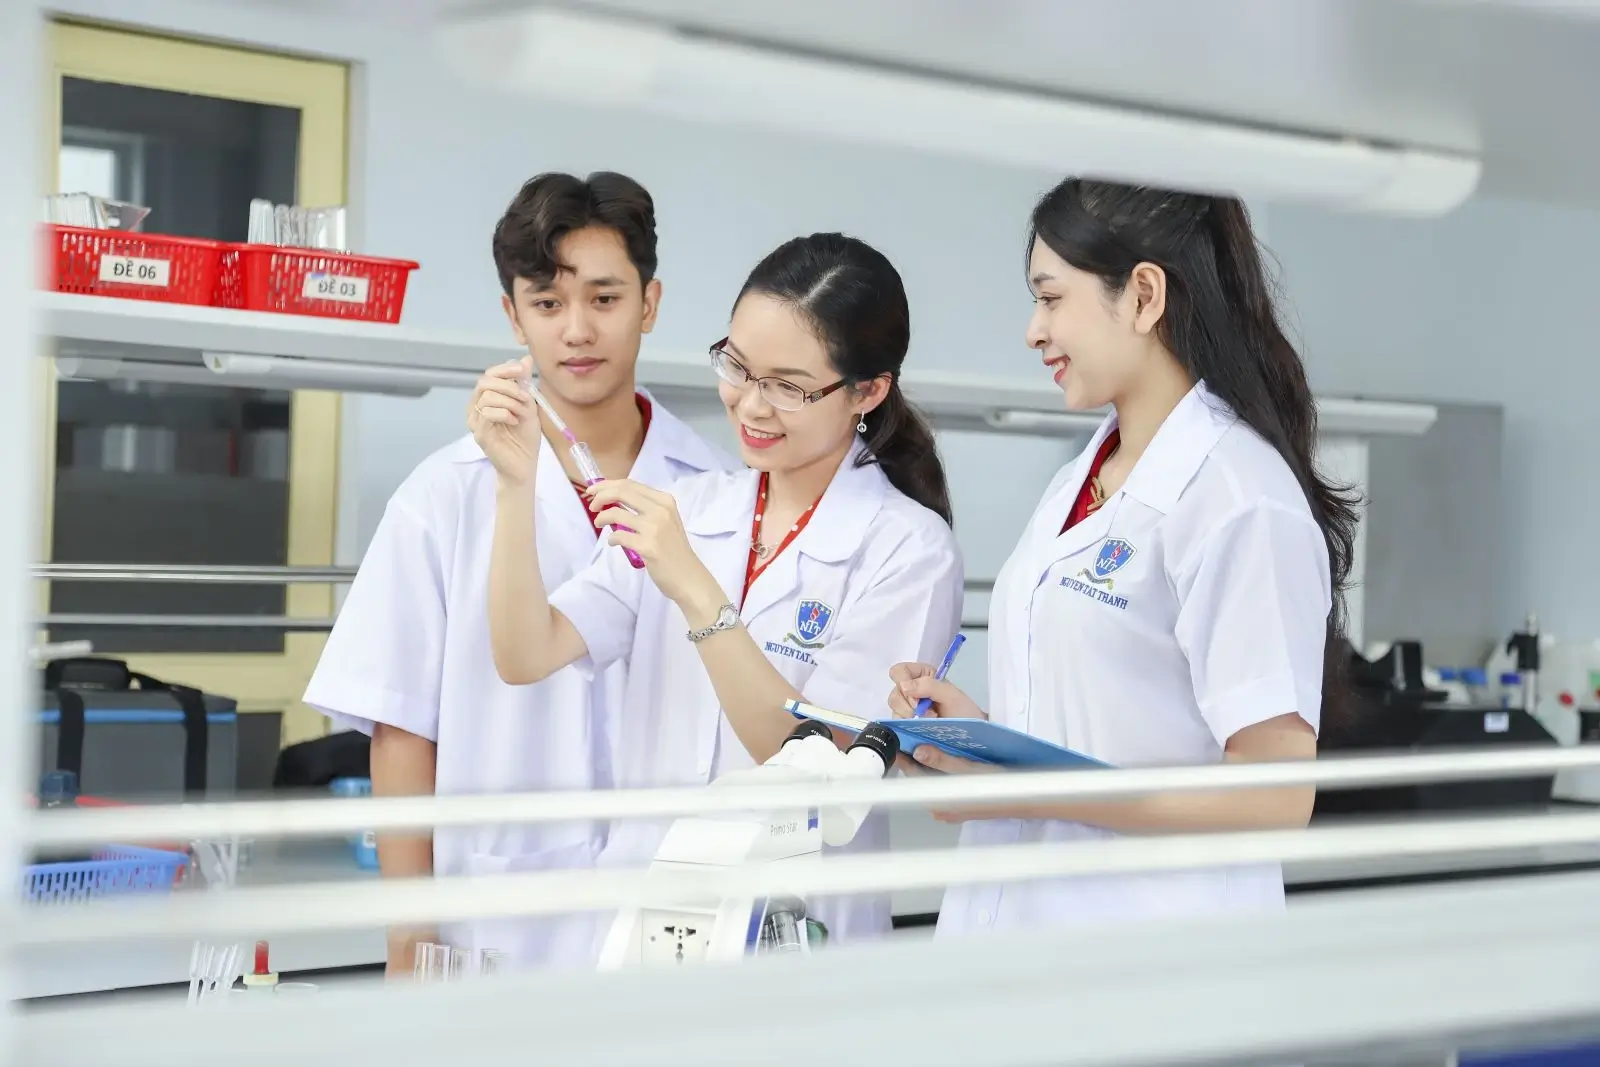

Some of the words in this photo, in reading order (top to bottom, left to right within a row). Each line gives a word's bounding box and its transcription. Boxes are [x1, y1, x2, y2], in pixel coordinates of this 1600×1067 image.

[138, 264, 157, 280] 06
[340, 282, 357, 297] 03
[1097, 590, 1129, 610] THANH
[764, 641, 796, 658] NGUYEN
